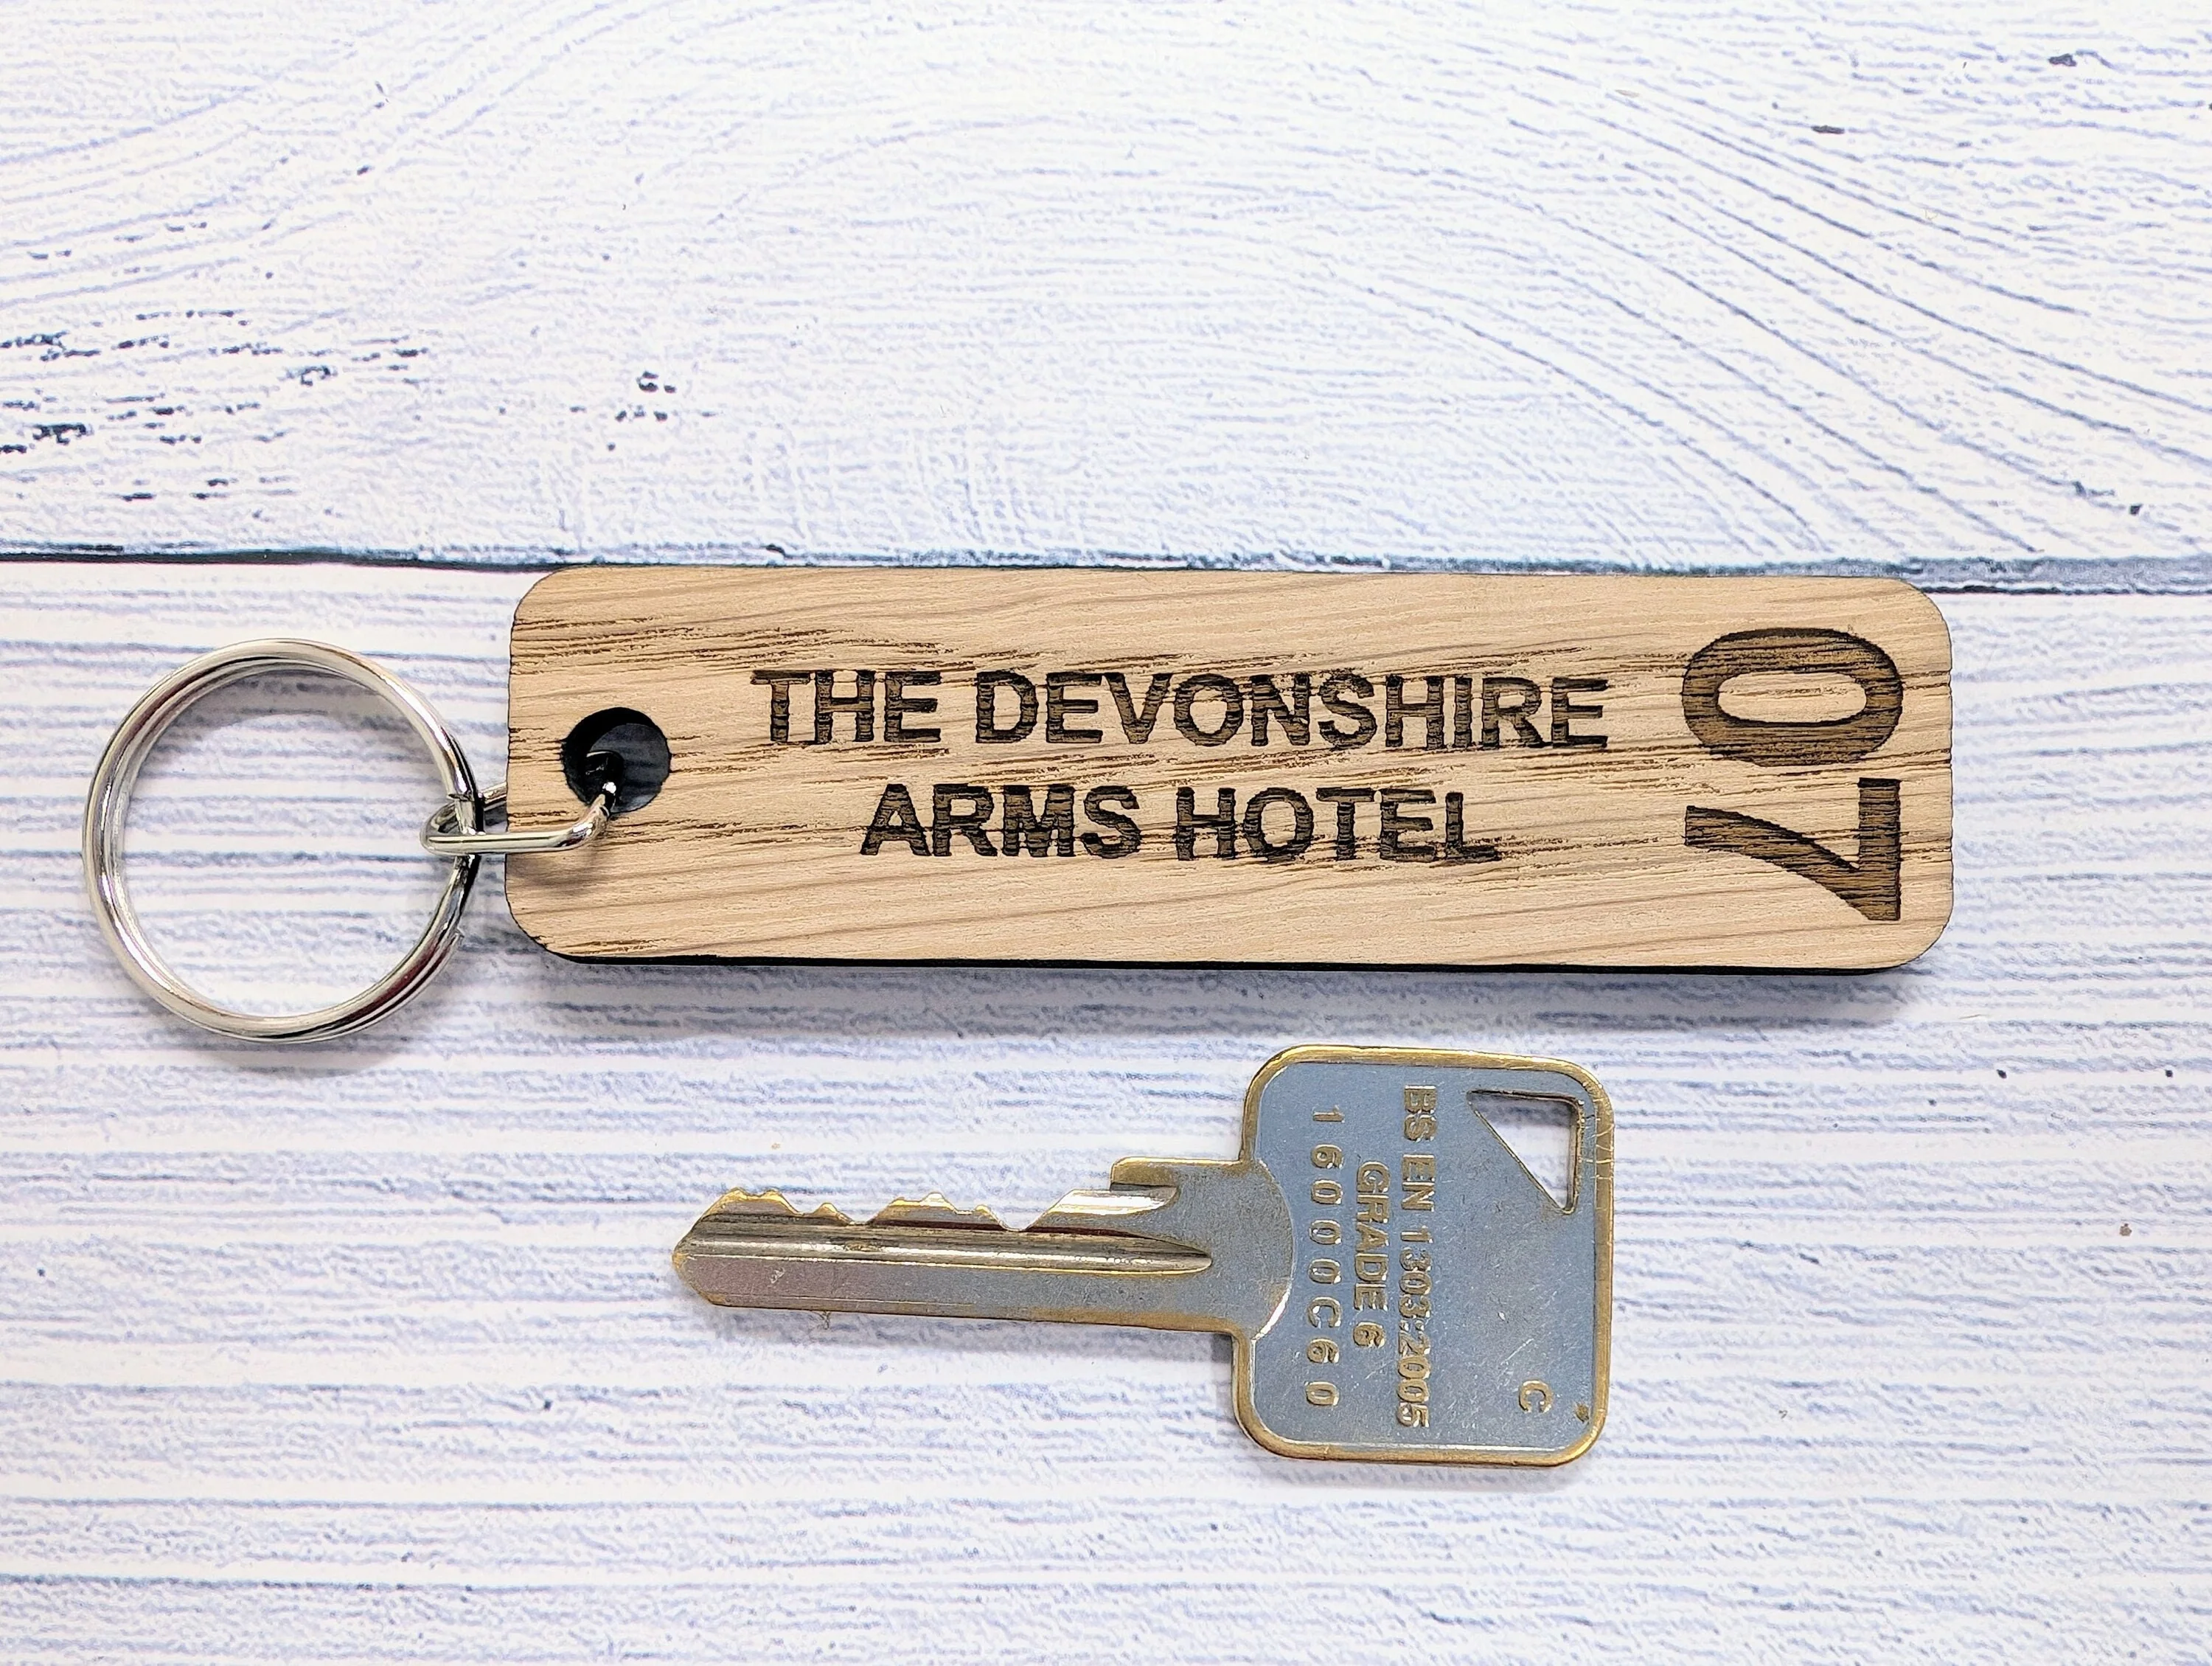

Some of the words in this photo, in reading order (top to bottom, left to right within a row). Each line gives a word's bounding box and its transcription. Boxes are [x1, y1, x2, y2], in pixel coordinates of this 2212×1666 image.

[750, 670, 941, 745] THE
[976, 667, 1609, 749] DEVONSHIRE
[1682, 628, 1903, 921] 07
[860, 783, 1141, 858] ARMS
[1175, 787, 1501, 864] HOTEL
[1401, 1085, 1436, 1142] BS
[1399, 1154, 1436, 1212] EN
[1354, 1160, 1389, 1311] GRADE
[1352, 1321, 1385, 1350] 6
[1396, 1225, 1431, 1429] 1303:2005
[1517, 1378, 1553, 1414] C
